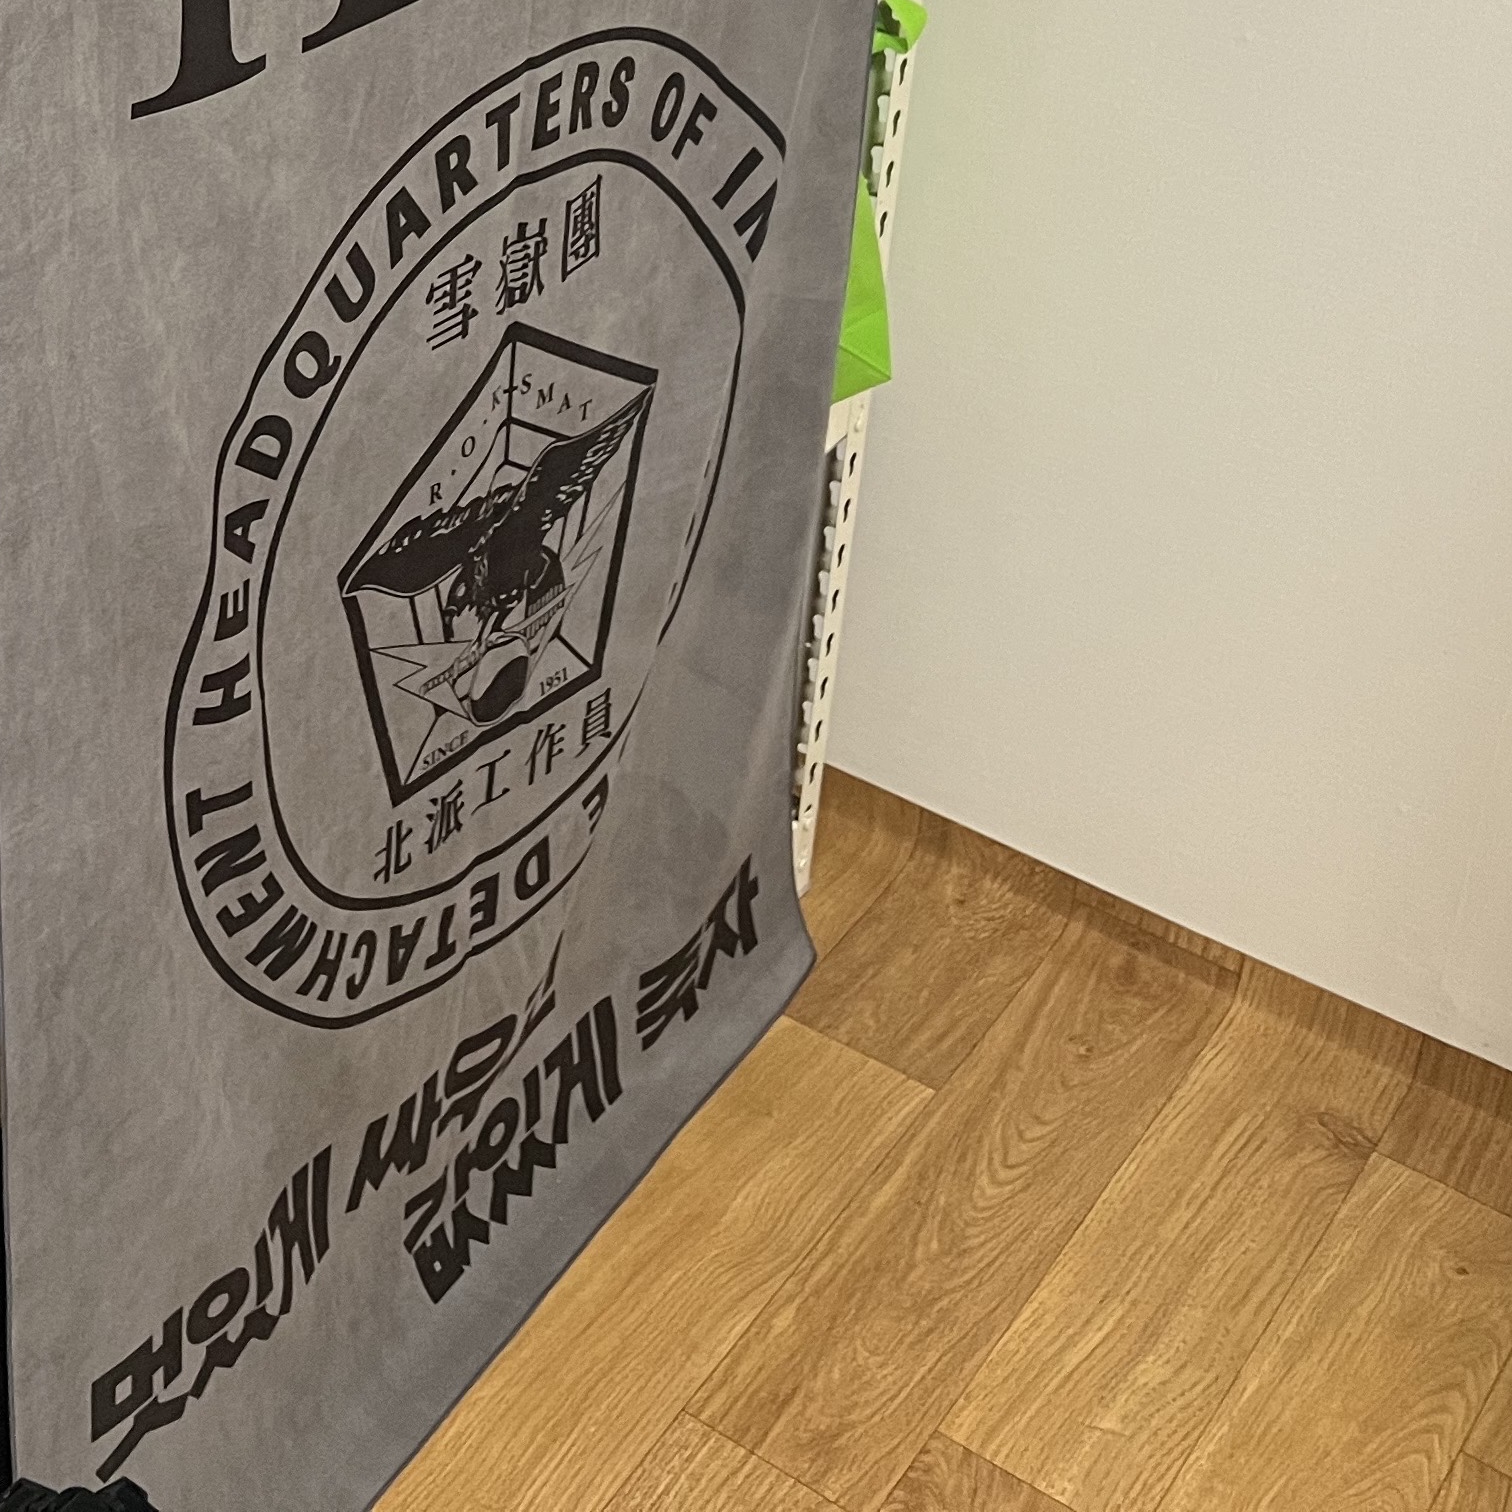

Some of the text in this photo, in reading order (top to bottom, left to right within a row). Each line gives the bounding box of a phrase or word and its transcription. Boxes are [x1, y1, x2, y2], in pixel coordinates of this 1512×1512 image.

[651, 73, 717, 160] OF
[192, 56, 636, 726] HEADQUARTERS
[373, 687, 612, 884] 北派工作員
[420, 667, 569, 771] SINCE 1951
[186, 781, 550, 1002] DETACHMENT
[403, 995, 623, 1305] 값있게
[91, 1143, 331, 1483] 멋있게
